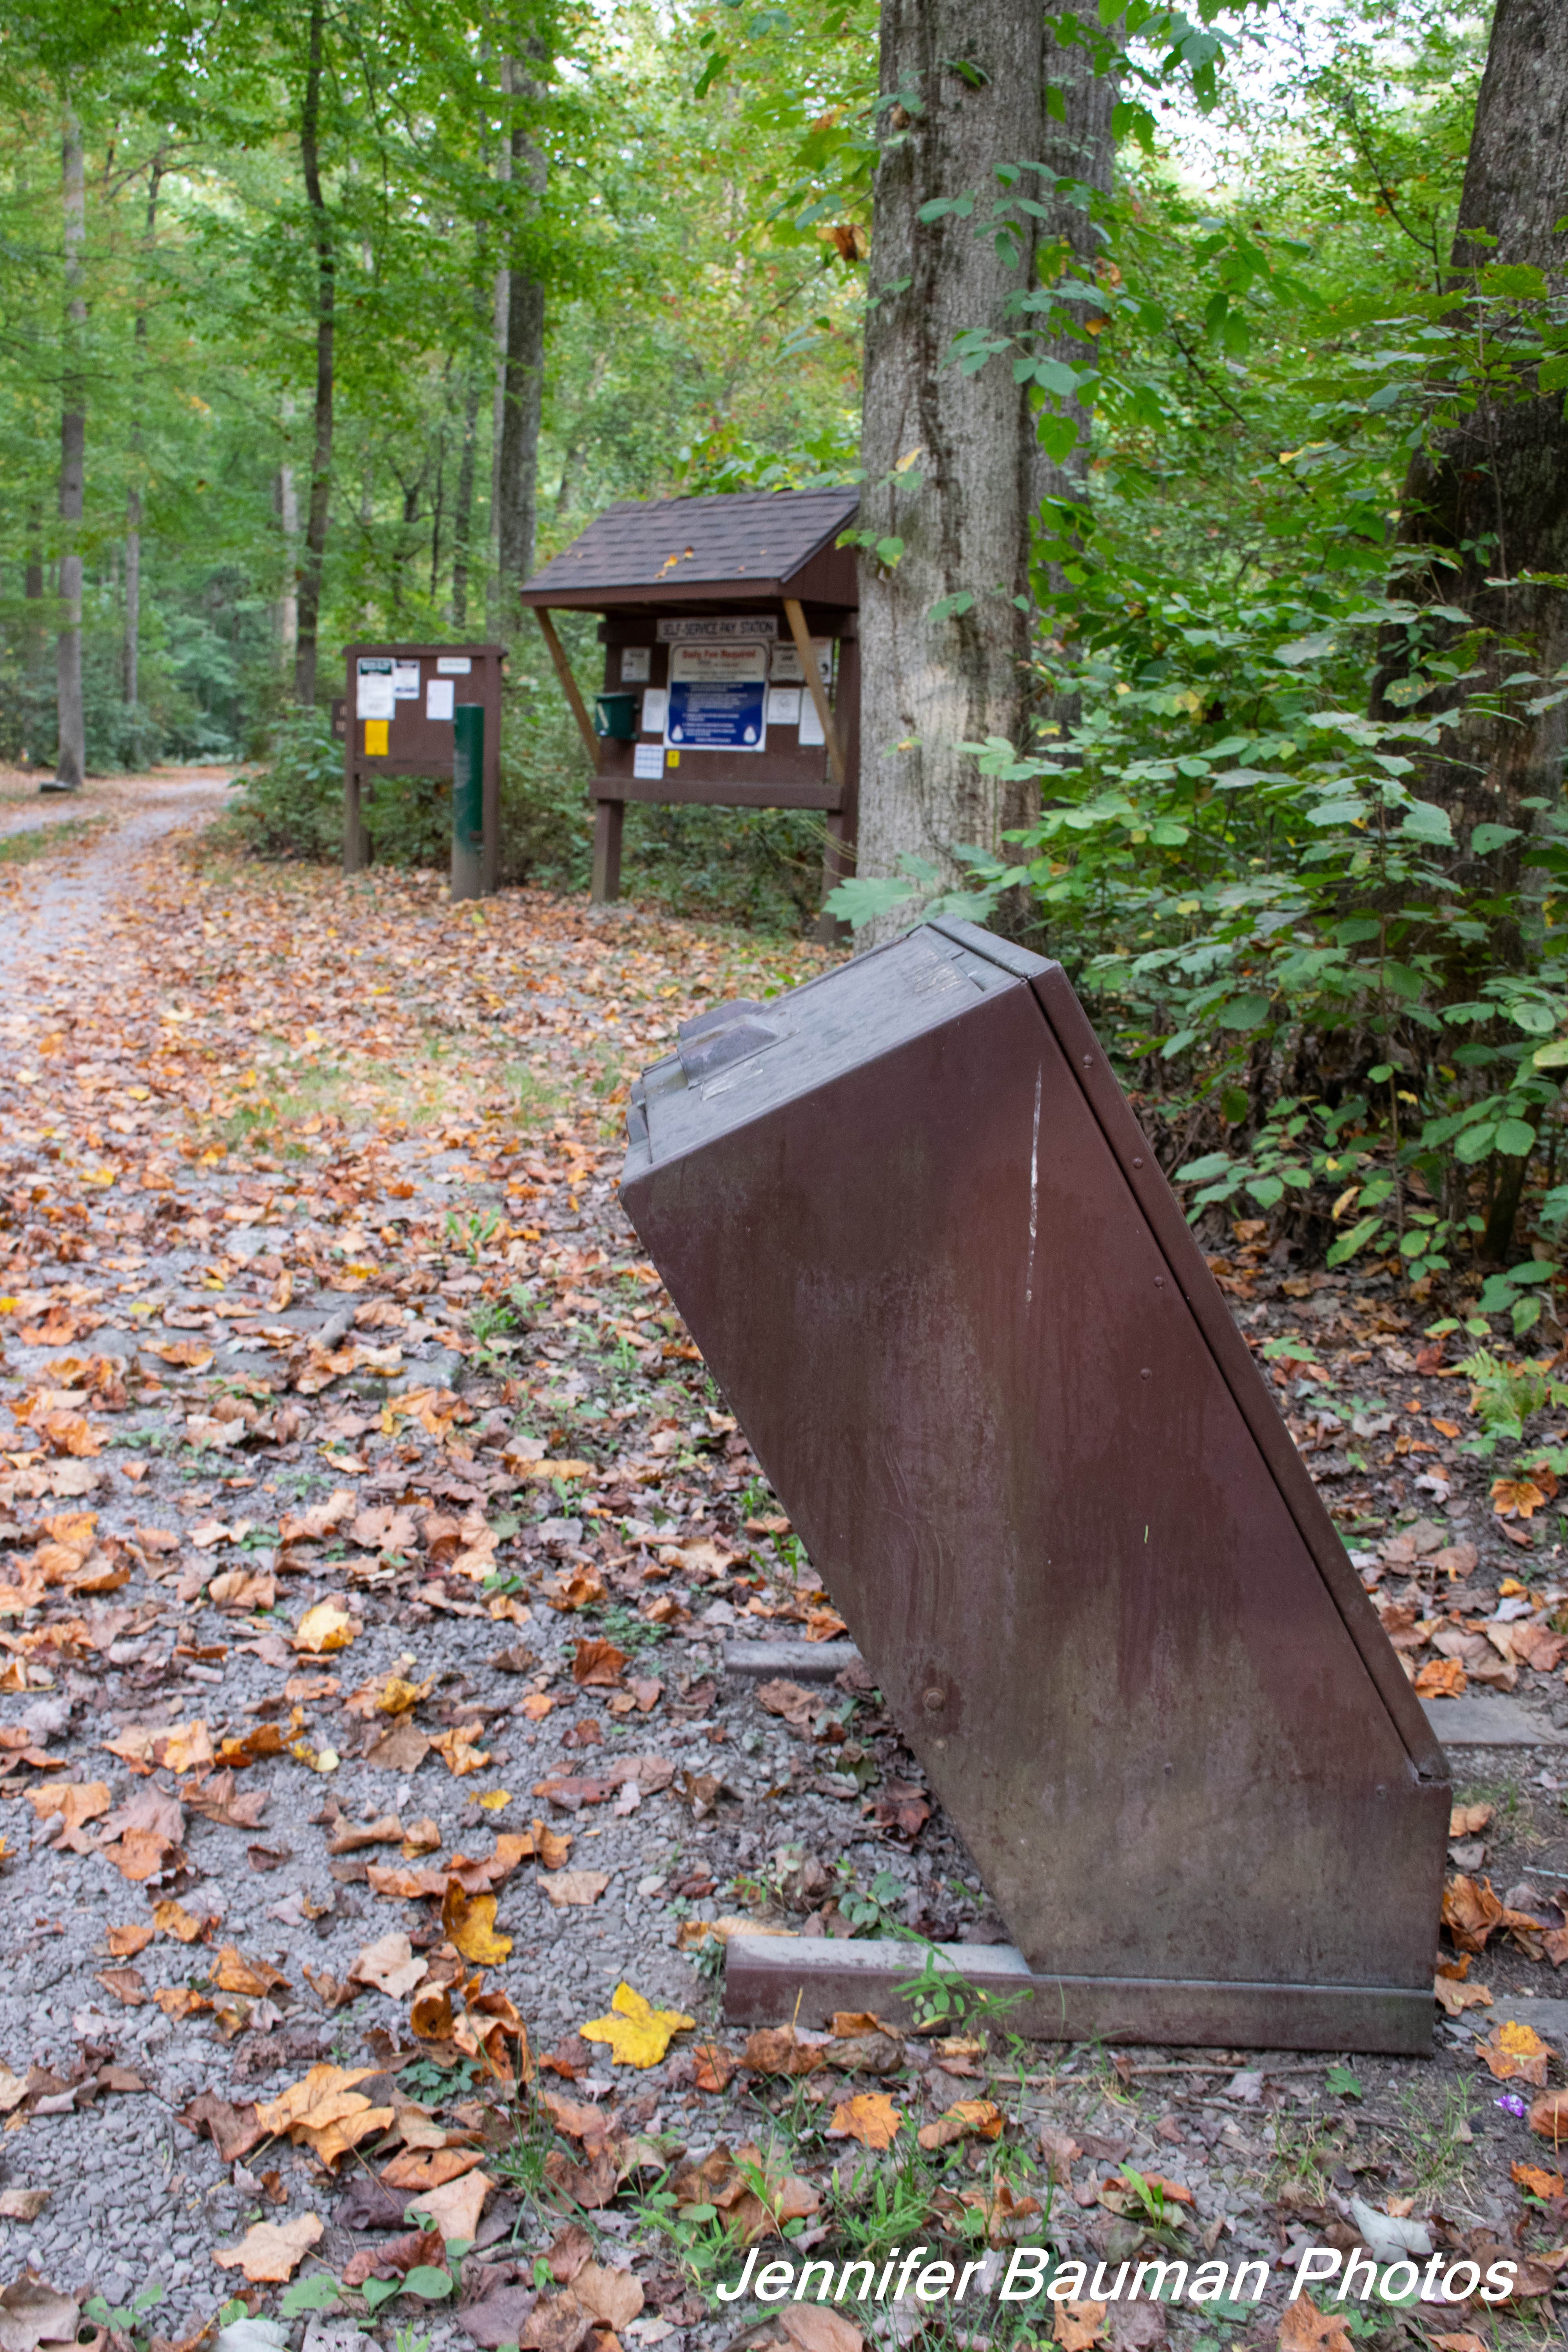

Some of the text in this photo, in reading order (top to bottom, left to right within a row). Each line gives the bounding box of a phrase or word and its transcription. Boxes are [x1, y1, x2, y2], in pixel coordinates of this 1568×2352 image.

[740, 620, 774, 634] STATION
[704, 649, 718, 658] Fee
[720, 649, 755, 659] Required
